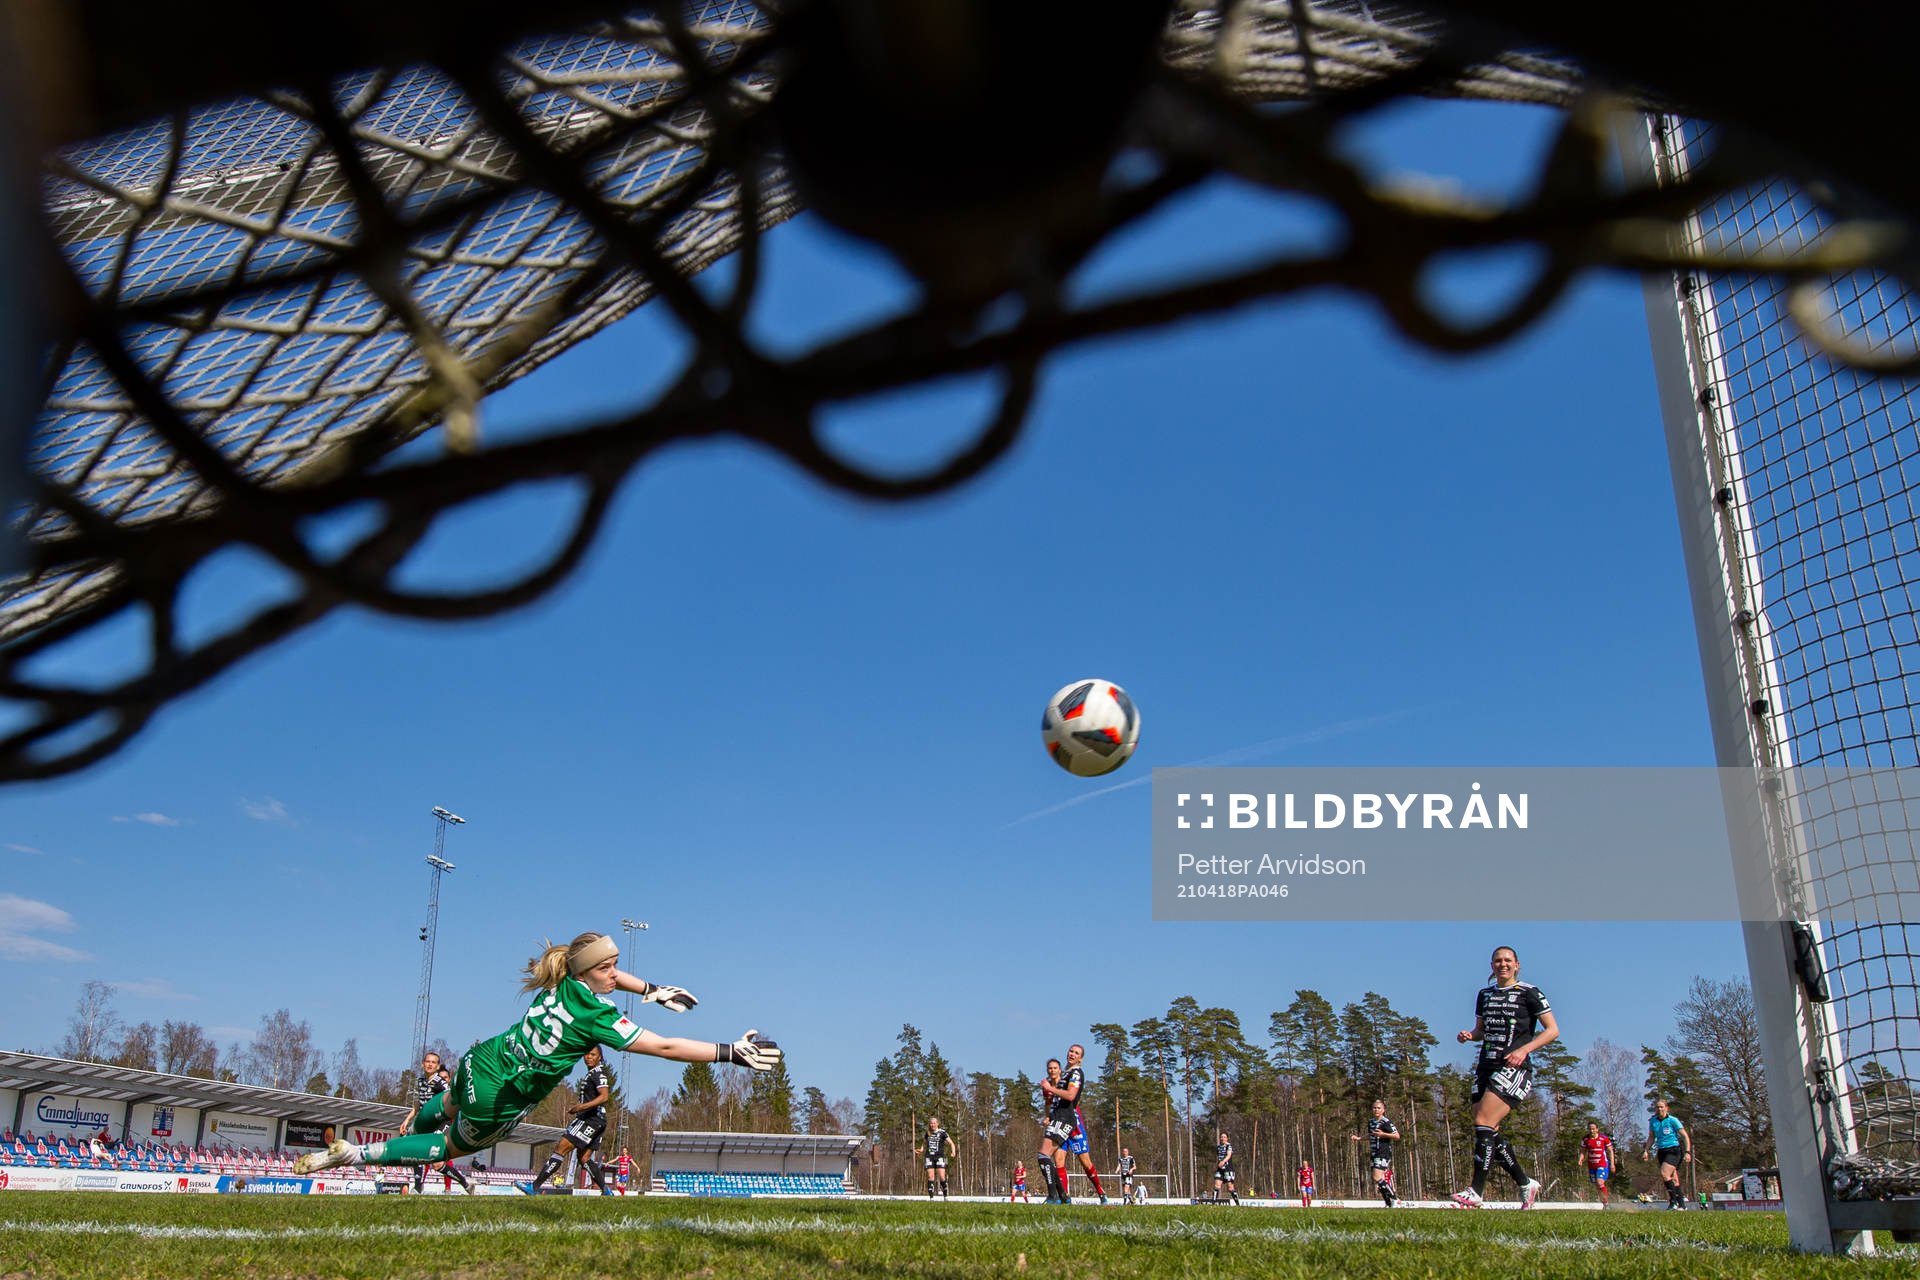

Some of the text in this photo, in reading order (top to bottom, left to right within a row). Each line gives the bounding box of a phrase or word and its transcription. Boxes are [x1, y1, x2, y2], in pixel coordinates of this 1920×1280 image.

[37, 1095, 110, 1130] Emmaljunga
[120, 1183, 162, 1191] GRUNDFOS
[248, 1181, 274, 1193] svensk
[275, 1182, 302, 1194] fotboll!
